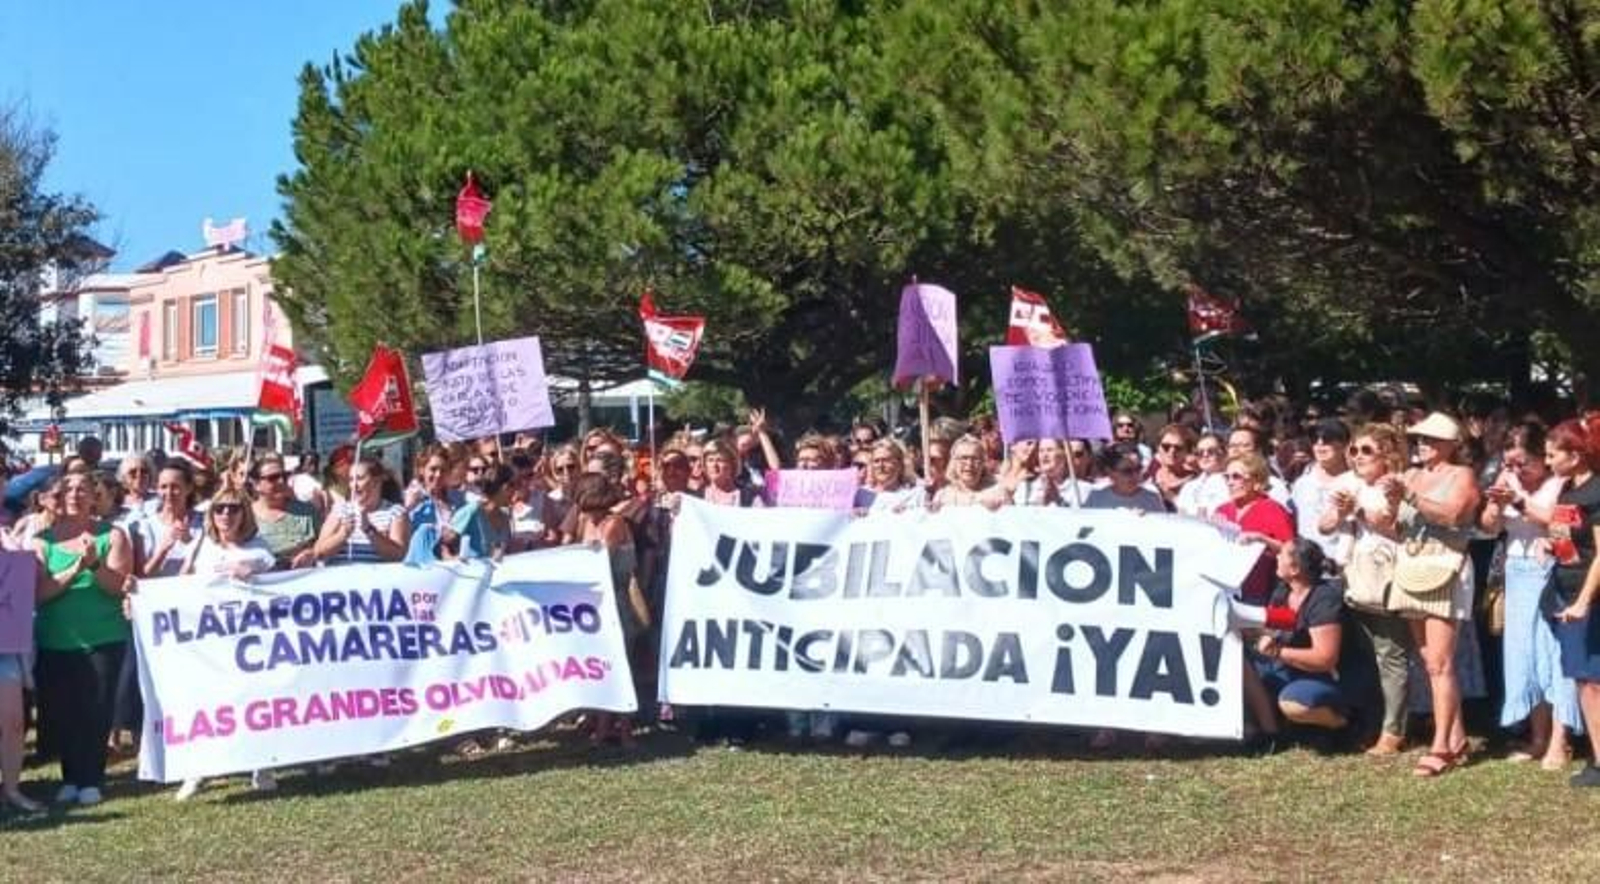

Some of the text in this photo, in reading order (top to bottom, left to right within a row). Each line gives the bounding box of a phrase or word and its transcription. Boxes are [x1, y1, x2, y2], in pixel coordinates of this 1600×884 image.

[697, 527, 1173, 608] JUBILACIÓN
[153, 588, 438, 646] PLATAFORMA por
[412, 607, 436, 622] las
[235, 621, 498, 673] CAMARERAS
[670, 618, 1223, 707] ANTICIPADA ¡YA!
[246, 687, 418, 732] GRANDES
